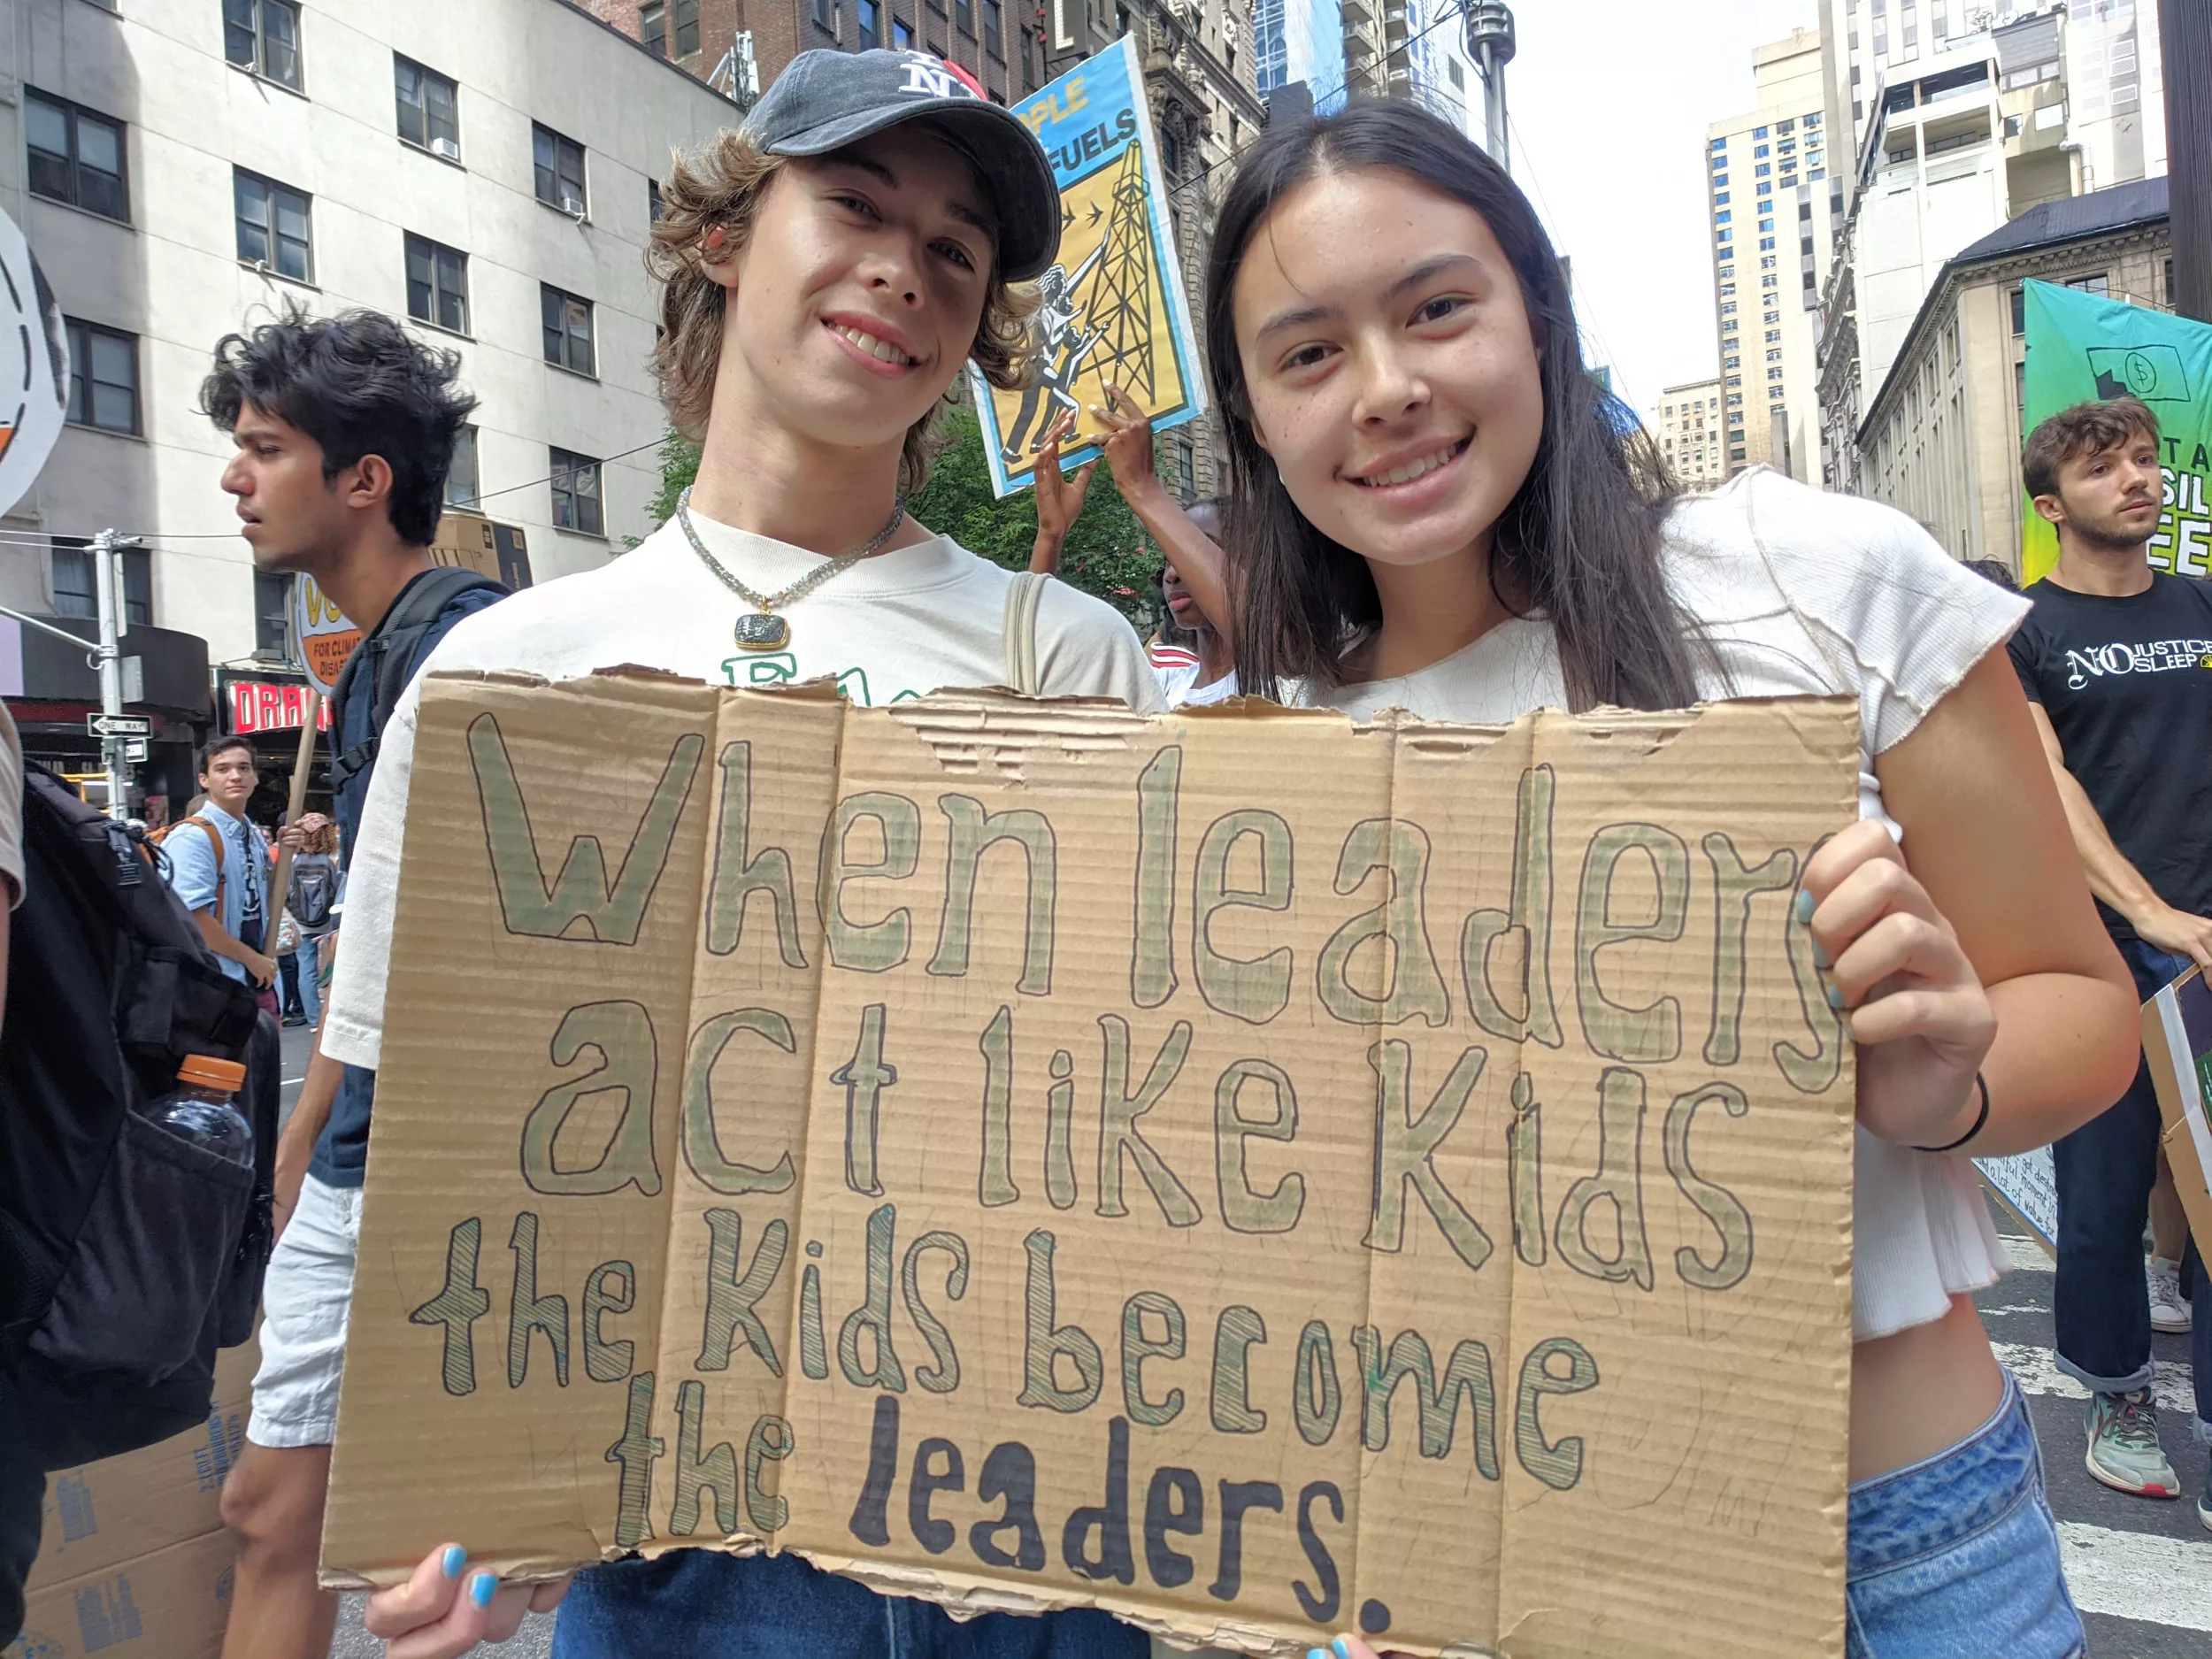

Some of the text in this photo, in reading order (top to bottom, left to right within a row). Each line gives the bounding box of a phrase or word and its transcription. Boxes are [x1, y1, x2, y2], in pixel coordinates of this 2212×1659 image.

[98, 721, 117, 730] ONE
[313, 642, 329, 657] FOR
[2134, 654, 2197, 672] SLEEP
[467, 711, 1843, 1094] When leaders
[520, 1000, 897, 1197] act
[409, 1211, 636, 1395] the
[1016, 1228, 1600, 1491] become
[605, 1371, 1391, 1634] the leaders.
